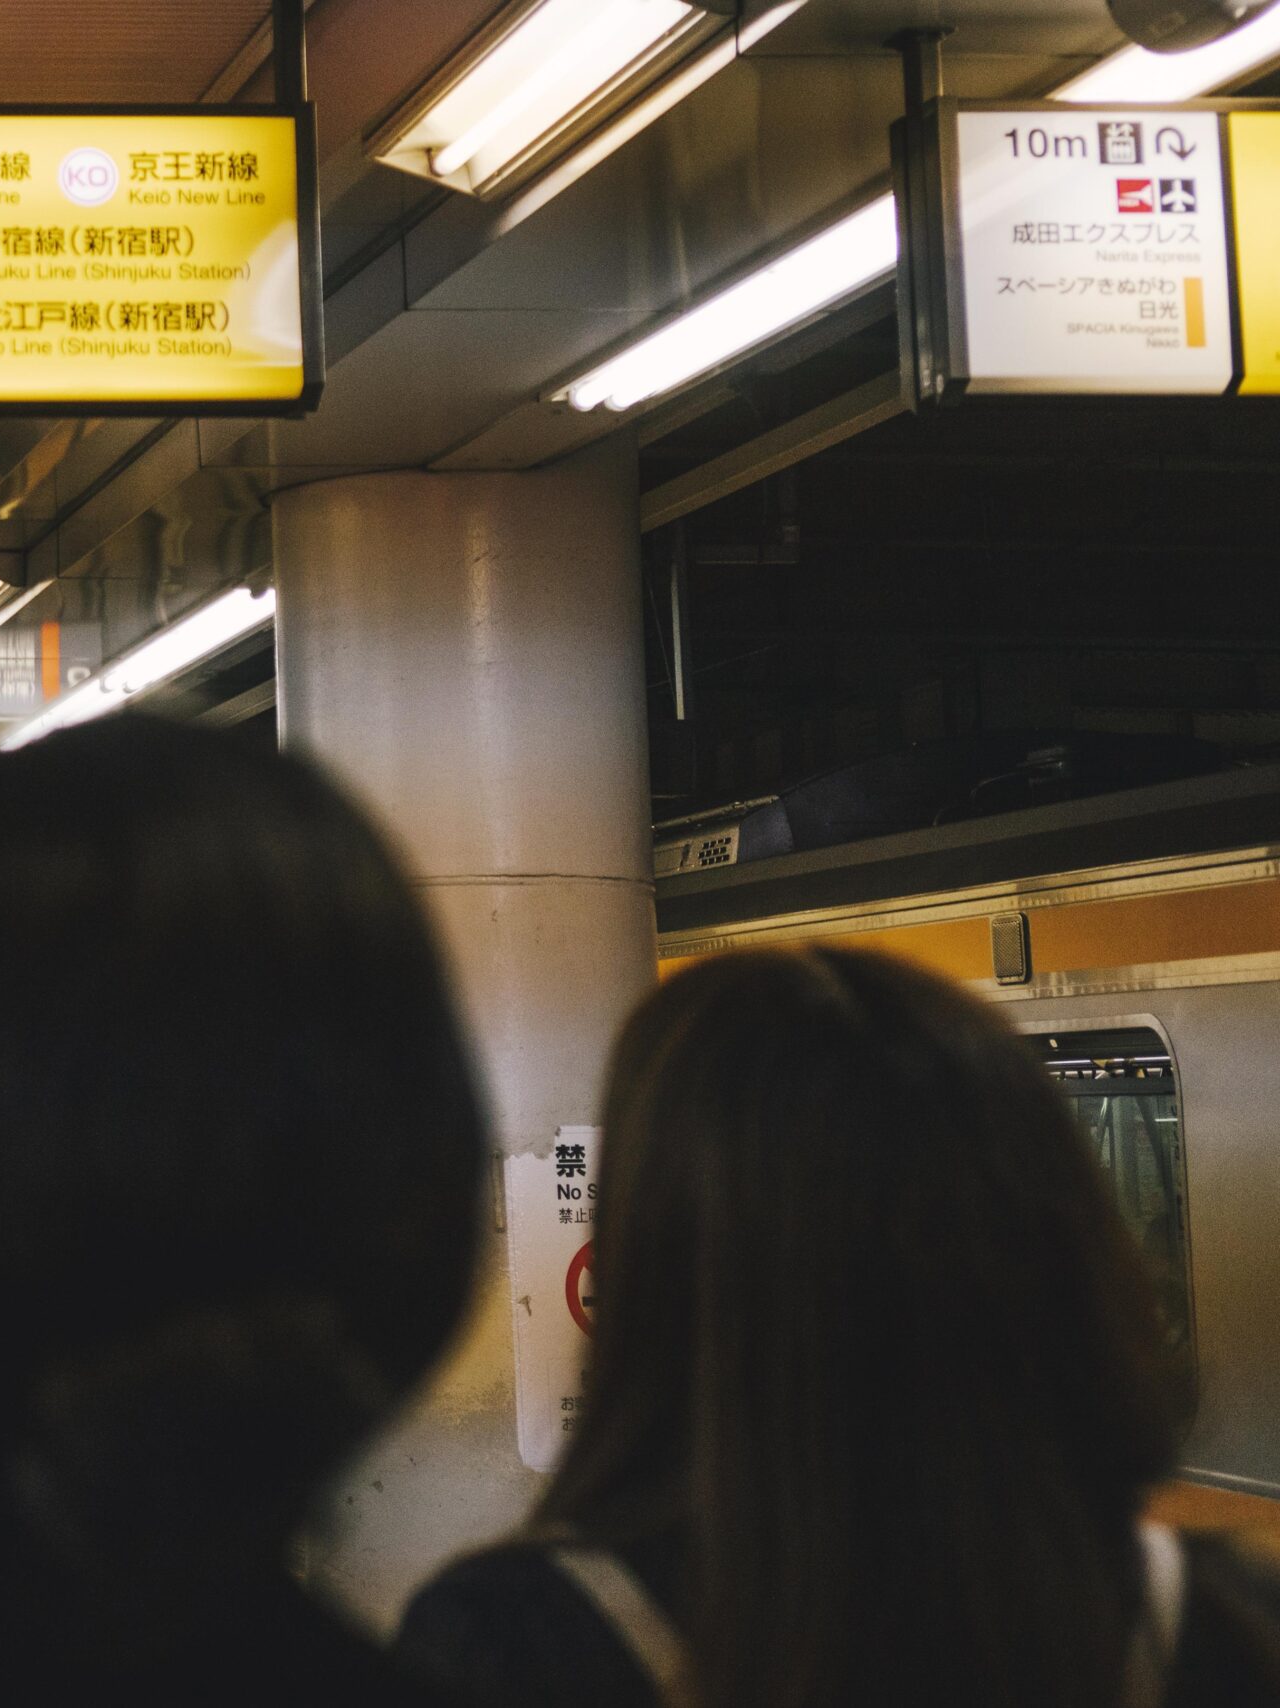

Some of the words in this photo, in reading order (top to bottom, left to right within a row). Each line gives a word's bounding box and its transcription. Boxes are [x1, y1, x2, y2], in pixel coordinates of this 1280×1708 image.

[1005, 128, 1089, 158] 10m
[67, 166, 109, 187] KO
[128, 151, 260, 182] 京王新線
[177, 189, 220, 205] New
[226, 189, 266, 205] Line
[1011, 222, 1200, 245] 成田エクスプレス
[36, 262, 76, 280] Line
[83, 261, 172, 284] (Shinjuku
[178, 261, 252, 281] Station)
[1139, 301, 1178, 320] 日光
[11, 338, 53, 356] Line
[59, 337, 151, 359] (Shinjuku
[158, 336, 232, 357] Station)
[556, 1144, 586, 1178] 禁
[557, 1183, 582, 1201] No
